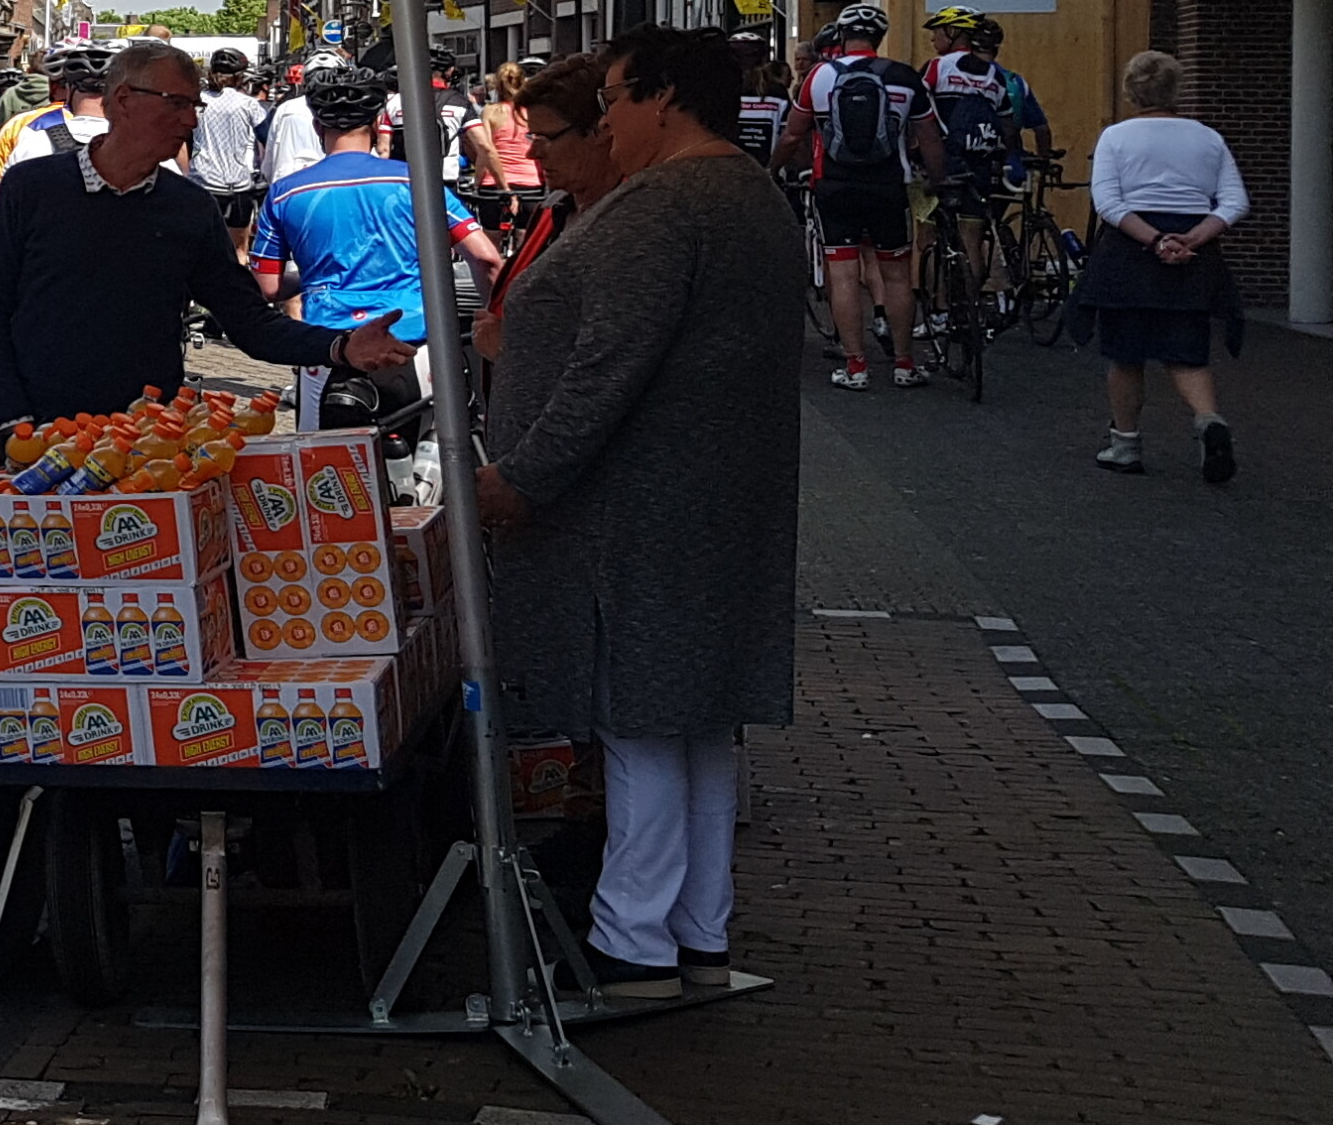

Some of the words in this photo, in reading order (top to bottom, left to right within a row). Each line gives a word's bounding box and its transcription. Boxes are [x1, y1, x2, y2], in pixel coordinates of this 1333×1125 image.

[331, 475, 347, 504] DRINK
[257, 494, 275, 522] DRINK
[116, 516, 141, 534] AA
[113, 526, 149, 544] DRINK
[22, 608, 46, 626] AA
[19, 622, 52, 638] DRINK
[87, 714, 105, 730] AA
[195, 705, 218, 724] AA
[84, 727, 113, 741] DRINK
[191, 719, 224, 735] DRINK
